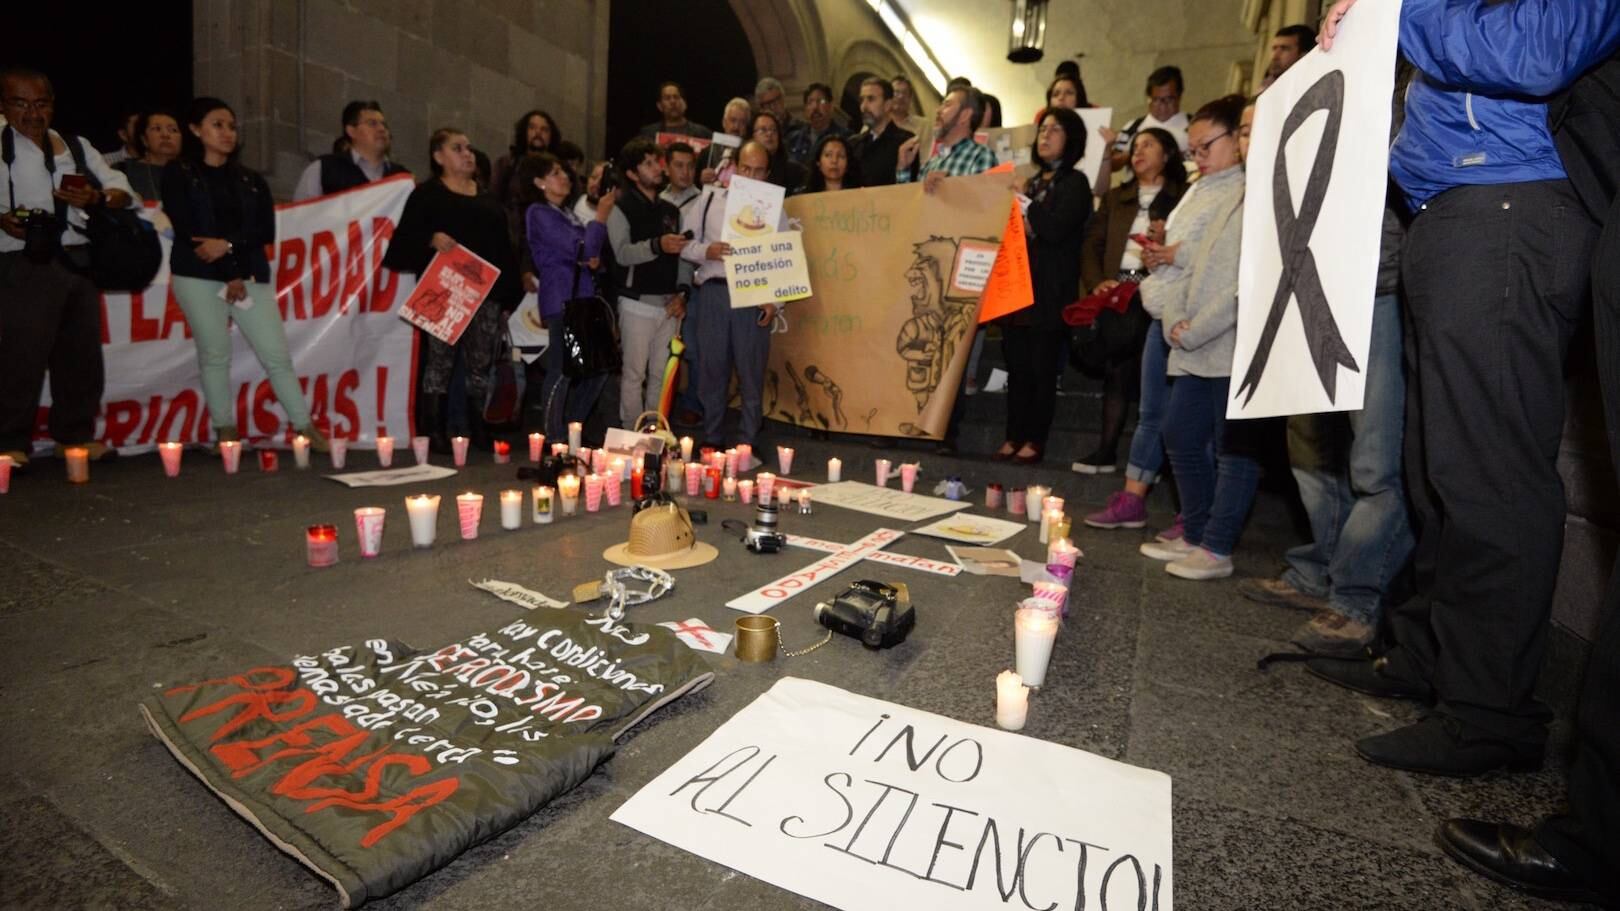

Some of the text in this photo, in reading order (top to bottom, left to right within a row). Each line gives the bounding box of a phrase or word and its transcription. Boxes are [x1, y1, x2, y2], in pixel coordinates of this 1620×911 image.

[730, 242, 793, 256] Amar una
[265, 215, 398, 321] RDAD
[735, 258, 793, 274] Profesión
[735, 276, 769, 289] no es
[774, 285, 808, 298] delito
[164, 666, 460, 849] PRENSA
[669, 745, 778, 828] AL
